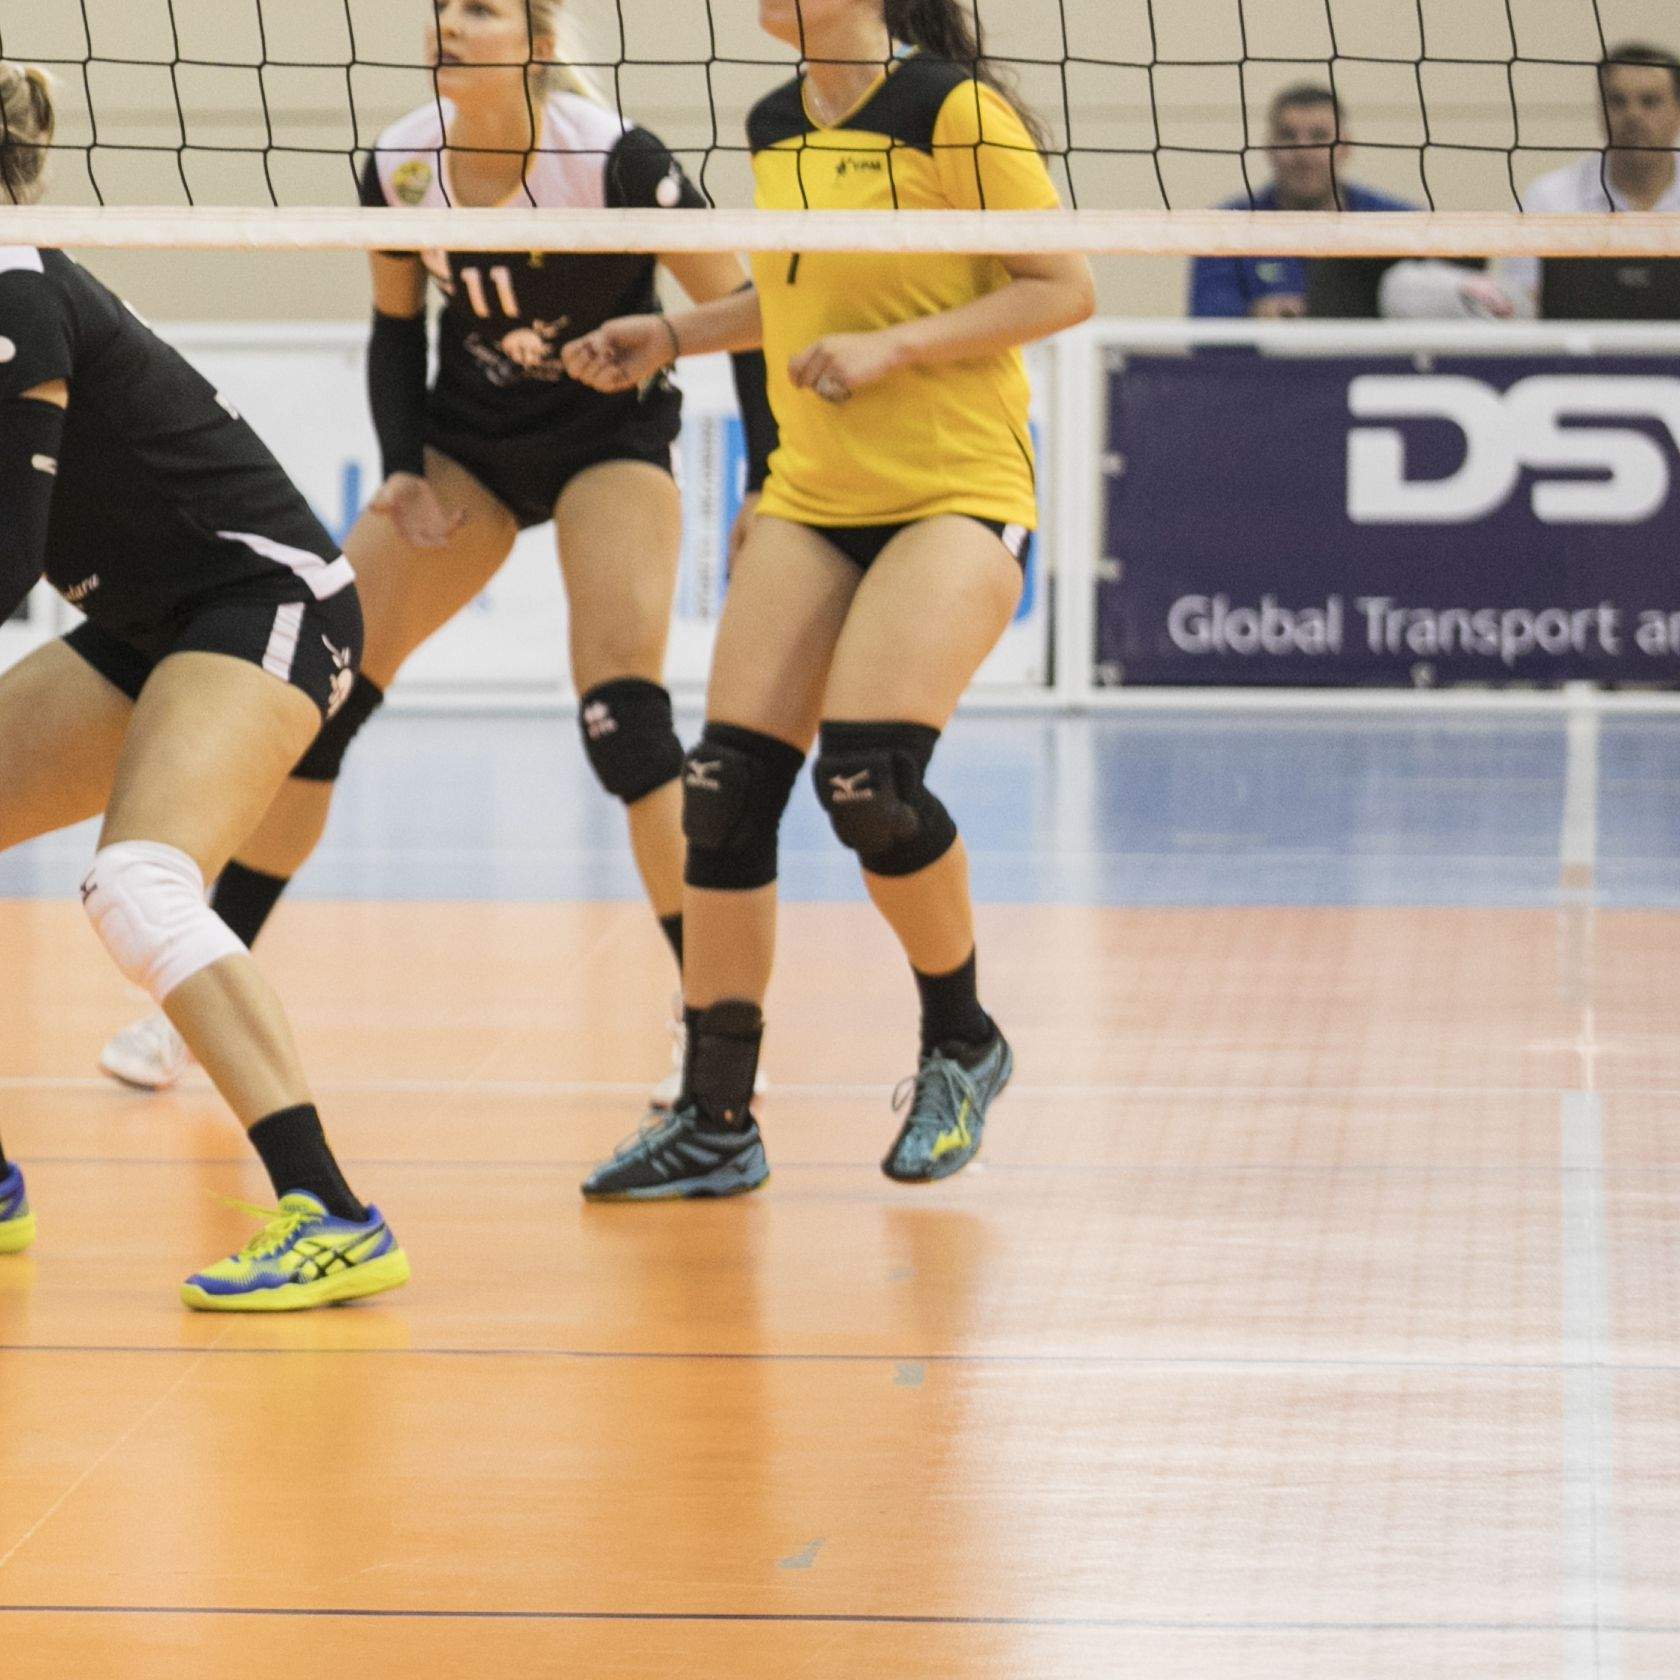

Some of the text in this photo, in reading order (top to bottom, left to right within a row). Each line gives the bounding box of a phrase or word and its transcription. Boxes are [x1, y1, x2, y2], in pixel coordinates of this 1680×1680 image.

[460, 266, 520, 319] 11
[1347, 375, 1680, 524] DS
[1168, 593, 1342, 655] Global
[1357, 596, 1622, 667] Transport
